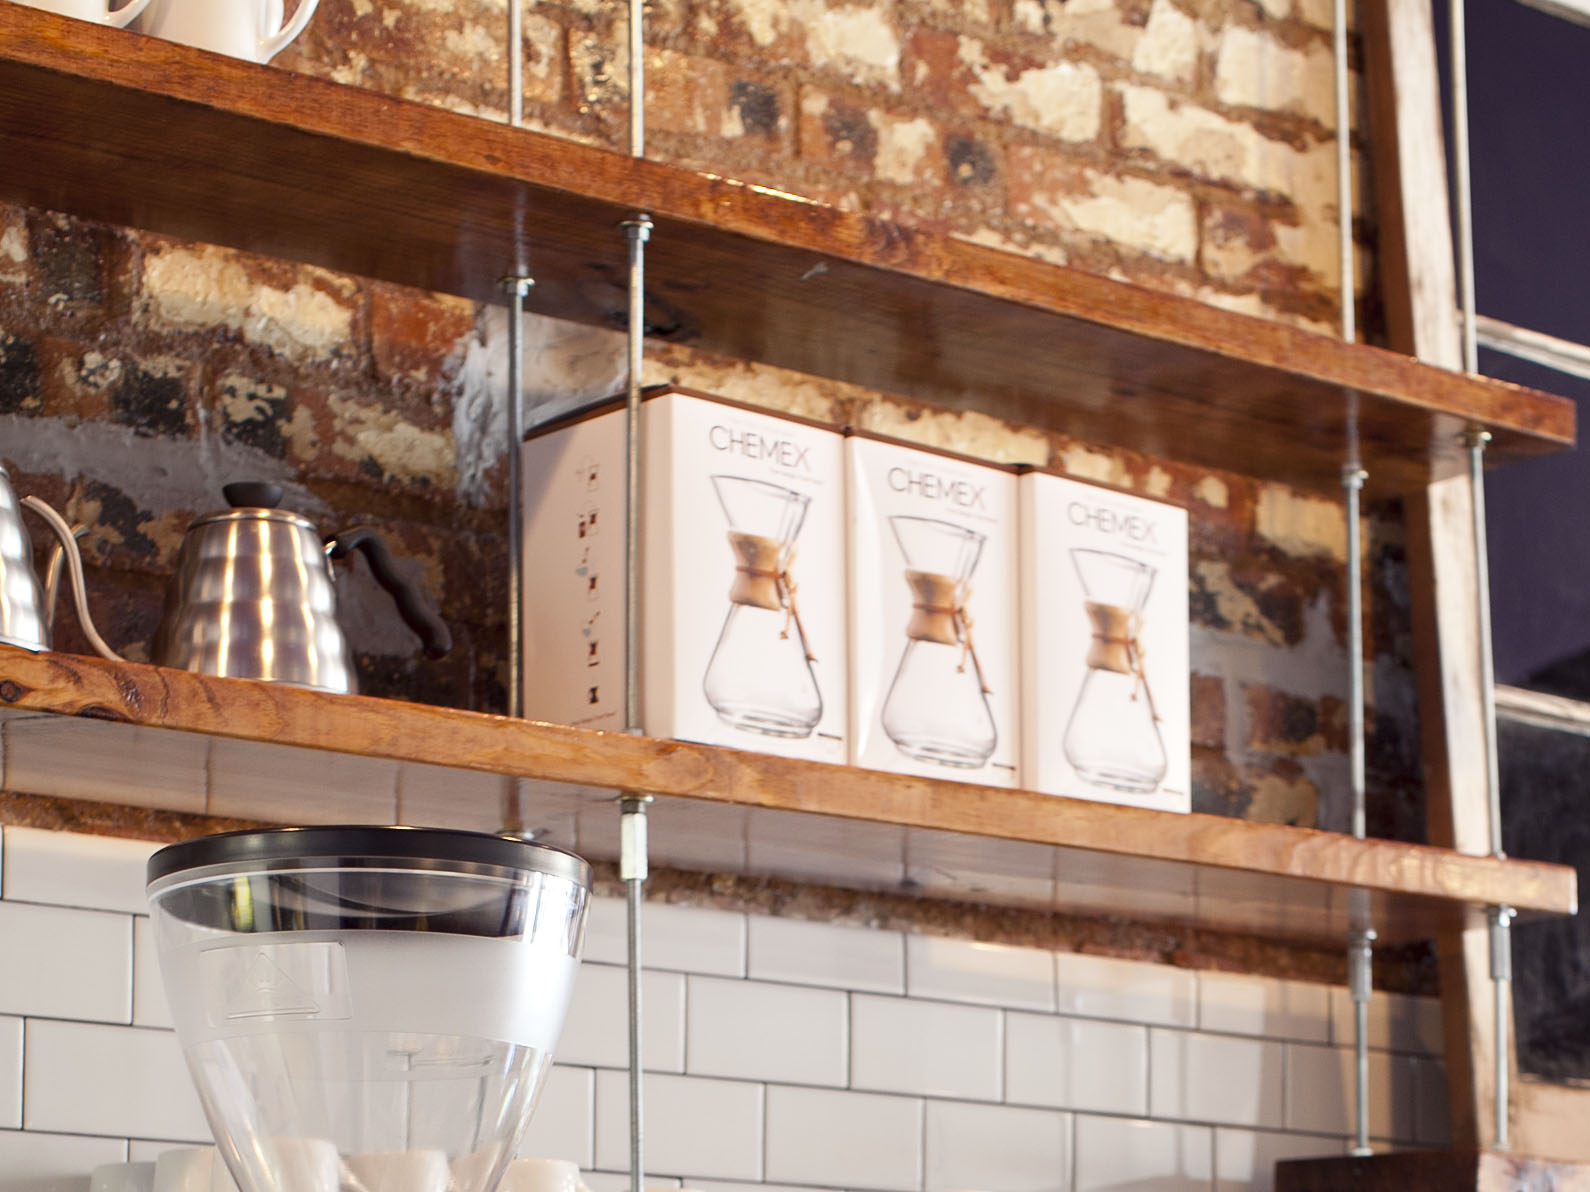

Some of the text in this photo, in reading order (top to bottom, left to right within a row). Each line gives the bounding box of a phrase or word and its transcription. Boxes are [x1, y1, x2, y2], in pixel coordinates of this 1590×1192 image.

[709, 425, 811, 472] CHEMEX
[887, 467, 986, 511] CHEMEX
[1067, 501, 1158, 544] CHEMEX
